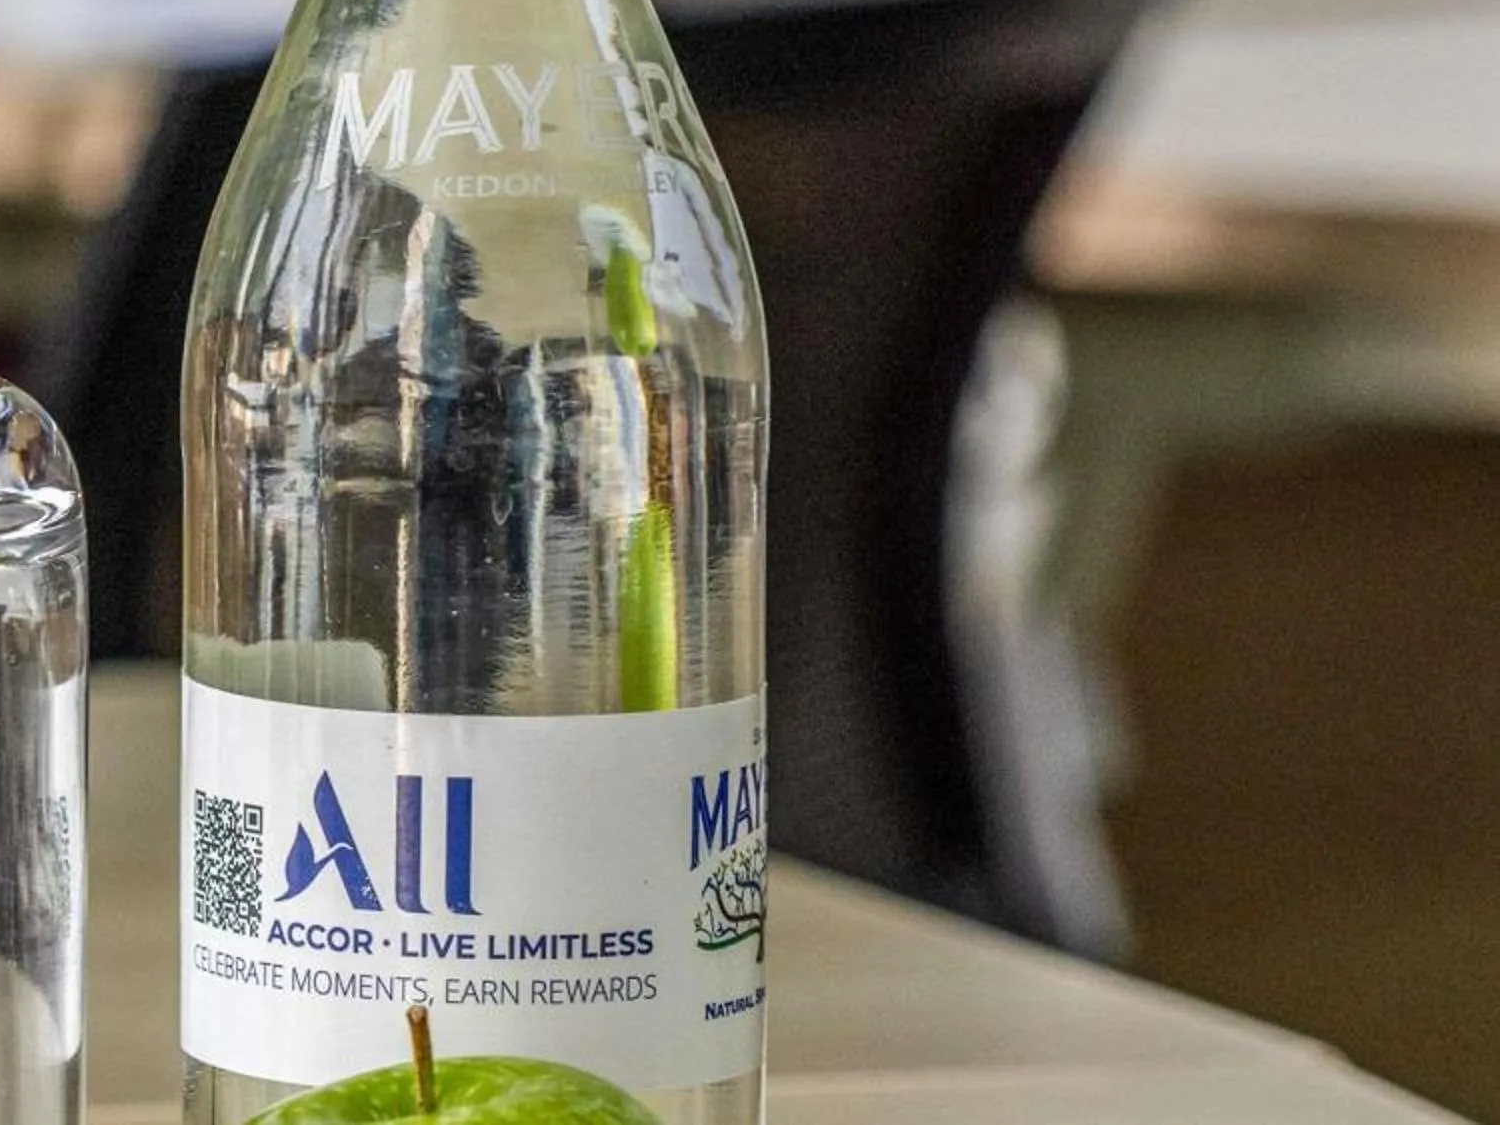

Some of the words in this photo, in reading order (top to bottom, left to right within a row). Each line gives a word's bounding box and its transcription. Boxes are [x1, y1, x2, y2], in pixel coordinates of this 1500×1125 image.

[297, 60, 726, 192] MAYER
[432, 174, 558, 199] KEDON
[689, 757, 766, 872] MAY
[266, 918, 374, 956] ACCOR
[400, 930, 476, 960] LIVE
[487, 928, 655, 961] LIMITLESS
[193, 942, 285, 991] CELEBRATE
[290, 966, 435, 1007] MOMENTS,
[444, 977, 520, 1006] EARN
[530, 973, 658, 1006] REWARDS
